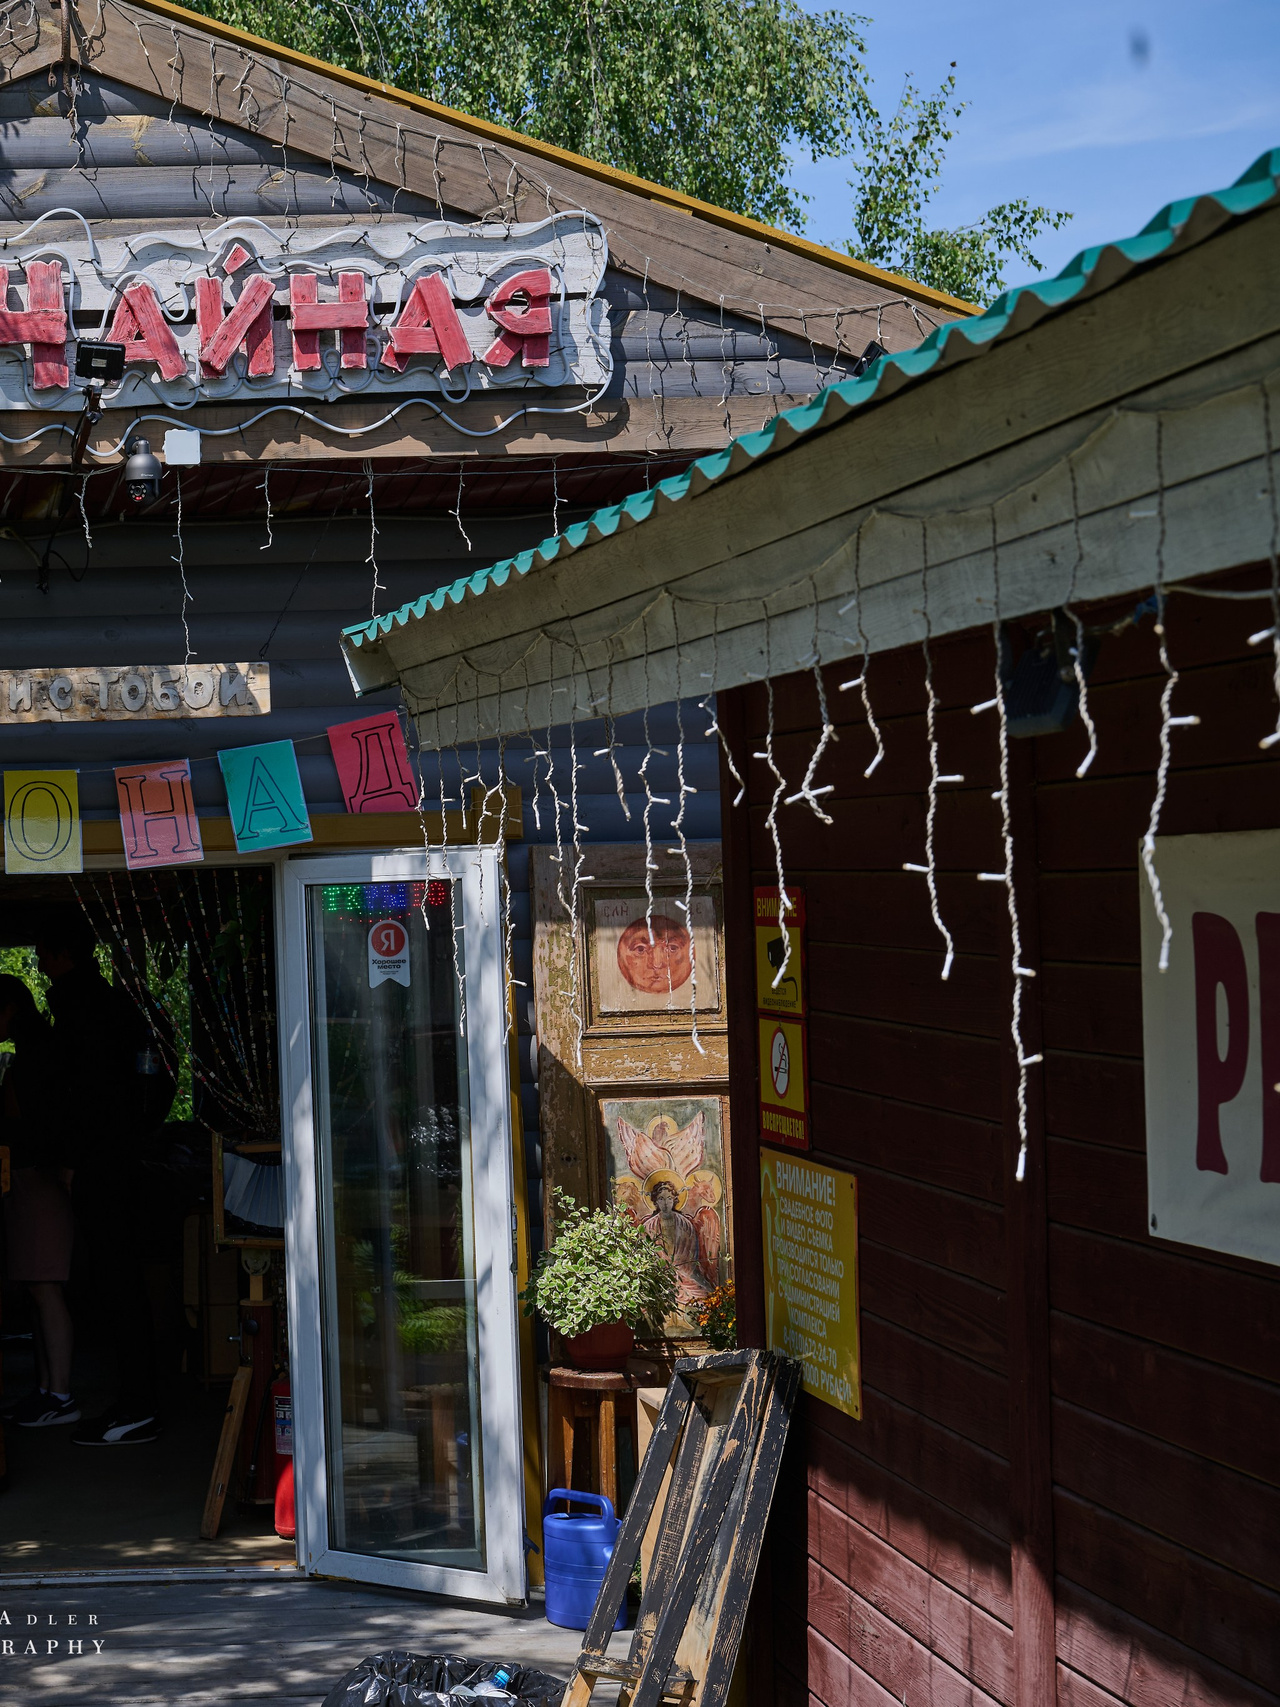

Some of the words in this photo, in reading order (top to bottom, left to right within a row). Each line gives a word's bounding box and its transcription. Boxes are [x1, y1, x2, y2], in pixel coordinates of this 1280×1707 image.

[8, 676, 34, 711] И
[48, 676, 74, 711] С
[85, 663, 250, 712] ТОБОЙ
[756, 897, 798, 918] ВНИМЕ
[381, 930, 396, 951] Я
[372, 958, 407, 966] Хорошее
[1192, 911, 1280, 1183] Р
[762, 1110, 805, 1140] ВОСПРЕЩАЕТСЯ!
[775, 1159, 836, 1208] ВНИМАНИЕ!
[778, 1194, 813, 1224] СВАДЕБНОЕ
[814, 1206, 833, 1231] ФОТО
[779, 1216, 785, 1234] И
[785, 1219, 805, 1242] ВИДЕО
[806, 1225, 833, 1253] СЪЕМКА
[771, 1234, 818, 1269] ПРОИЗВОДИТСЯ
[819, 1252, 844, 1279] ТОЛЬКО
[776, 1256, 788, 1277] ПРИ
[789, 1262, 839, 1299] СОГЛАСОВАНИИ
[777, 1279, 783, 1298] С
[784, 1282, 840, 1323] АДМИНИСТРАЦИЕЙ
[789, 1306, 827, 1339] КОМПЛЕКСА
[819, 1365, 851, 1405] РУБЛЕЙ!
